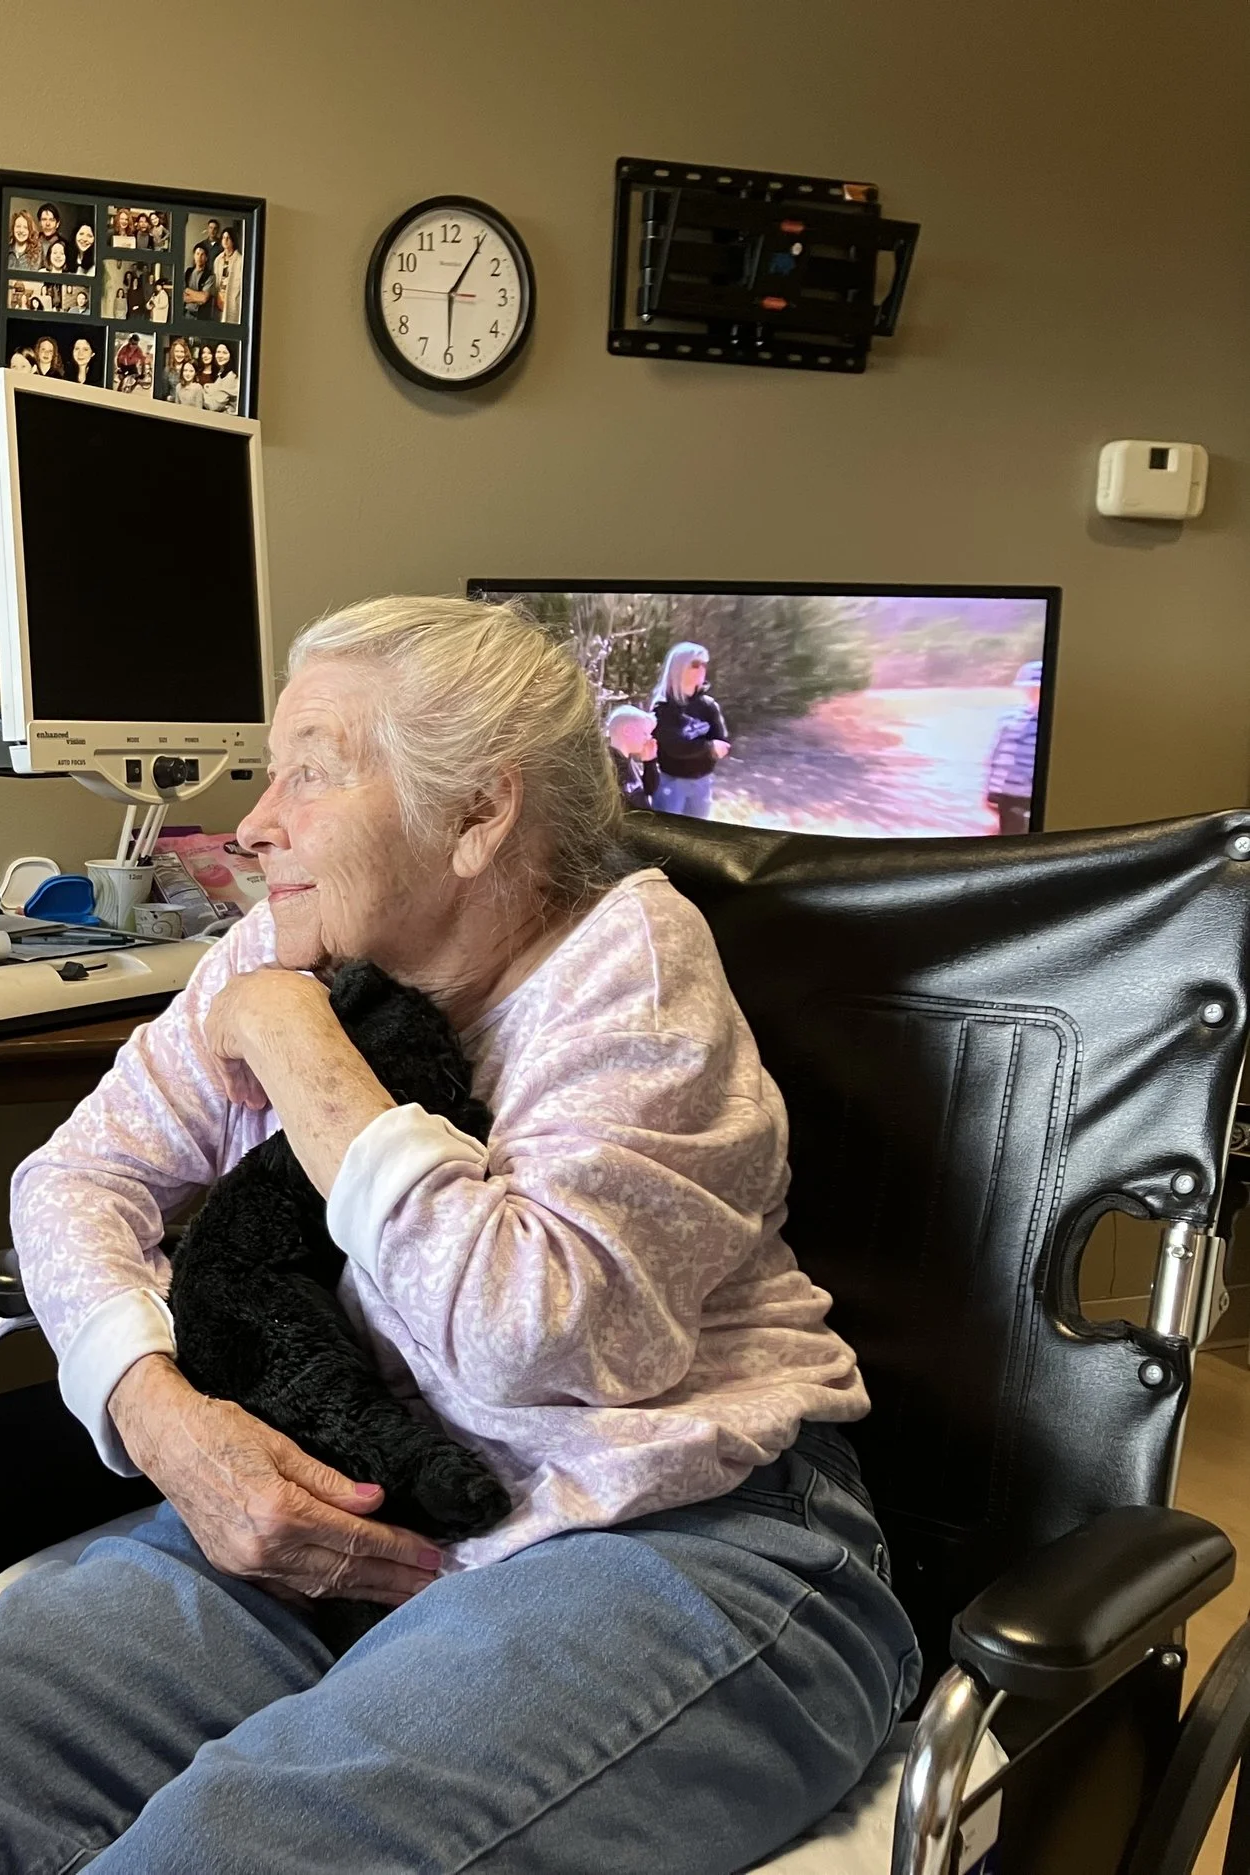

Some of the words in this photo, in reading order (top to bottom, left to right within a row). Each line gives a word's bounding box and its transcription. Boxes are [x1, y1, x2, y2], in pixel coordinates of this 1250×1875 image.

[417, 231, 435, 251] 11
[440, 223, 462, 243] 12
[473, 234, 482, 254] 1
[397, 252, 417, 272] 10
[490, 257, 501, 277] 2
[392, 282, 403, 302] 9
[497, 287, 508, 307] 3
[398, 314, 409, 335] 8
[489, 319, 500, 338] 4
[417, 336, 429, 356] 7
[443, 345, 454, 365] 6
[469, 338, 481, 358] 5
[36, 731, 69, 739] enhanced
